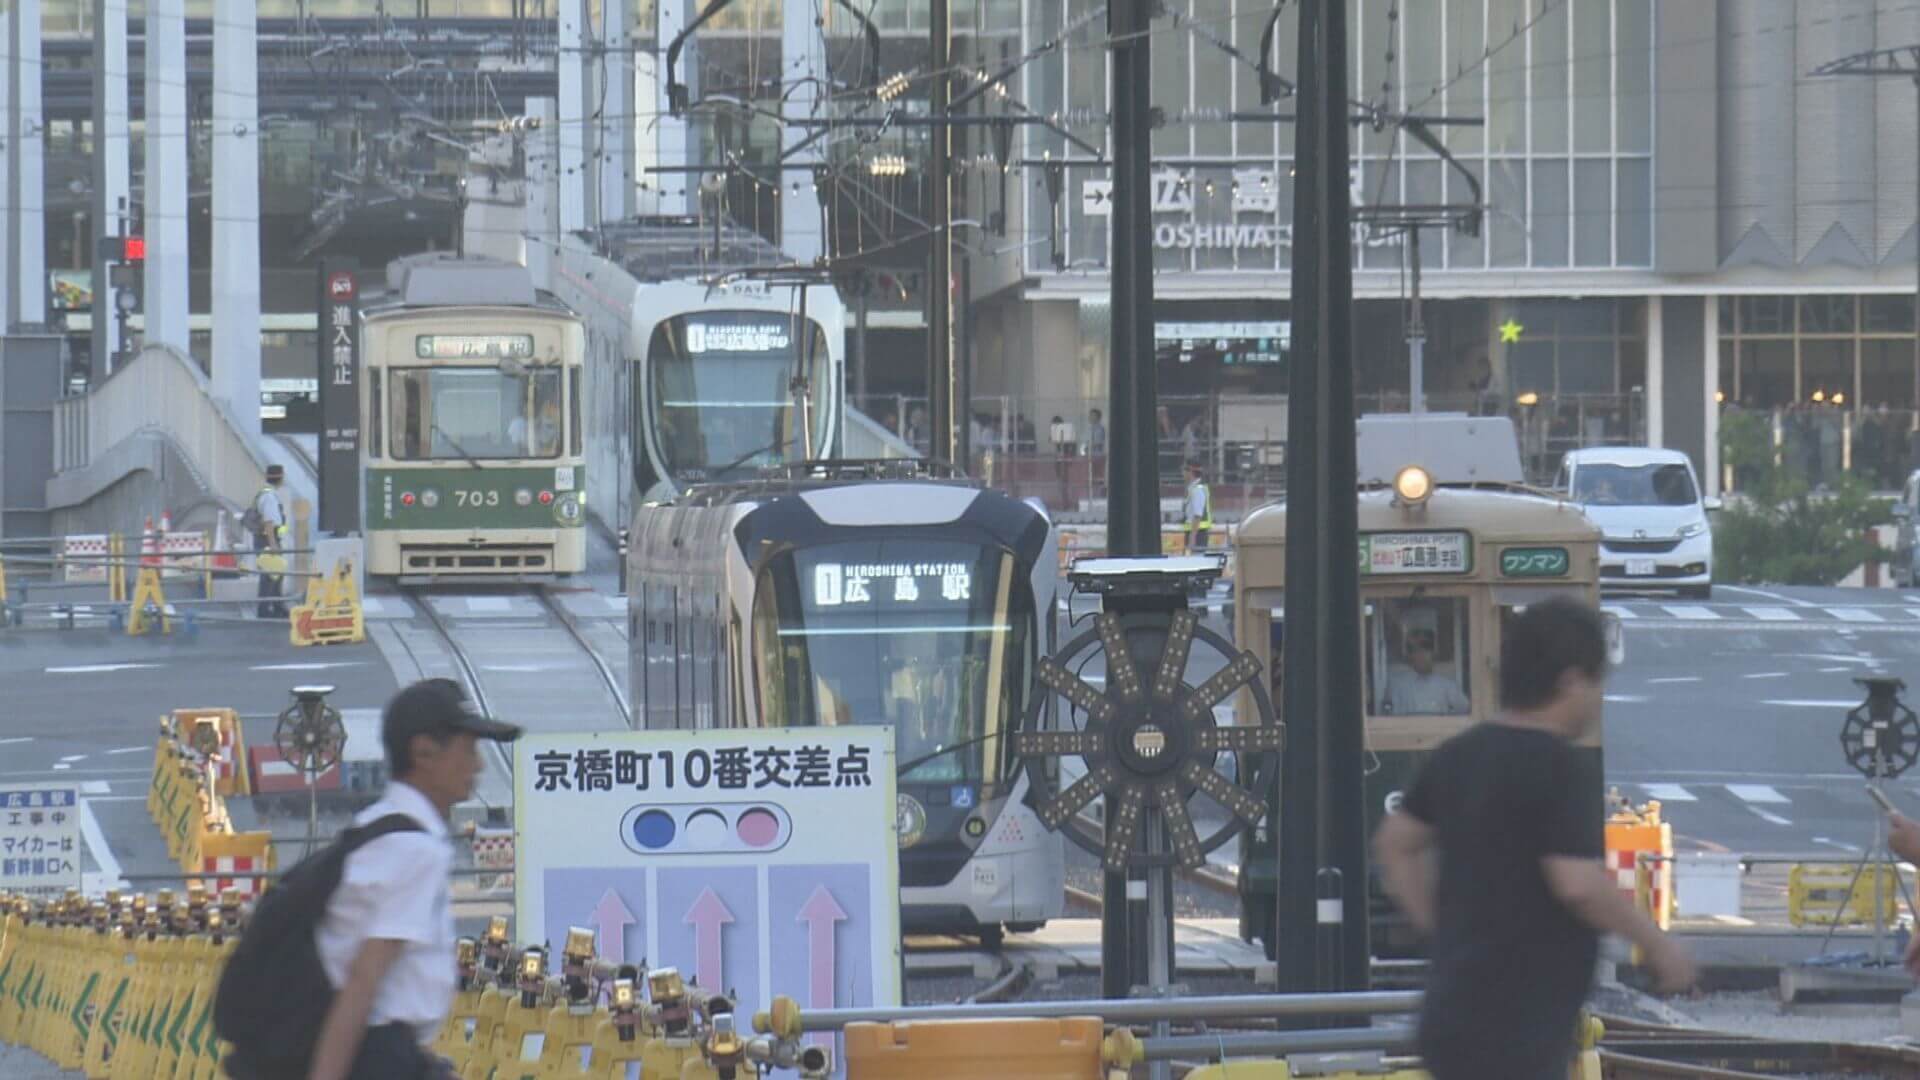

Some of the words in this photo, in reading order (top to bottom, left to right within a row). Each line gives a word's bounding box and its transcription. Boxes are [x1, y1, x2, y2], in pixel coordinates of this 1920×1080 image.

[333, 305, 352, 384] 進入禁止
[455, 491, 499, 506] 703
[846, 564, 911, 577] HIROSHIMA
[915, 563, 966, 577] STATION
[1504, 555, 1564, 571] ワンマン
[534, 745, 871, 792] 京橋町10番交差点
[8, 812, 65, 827] 工事中
[3, 836, 73, 853] マイカーは
